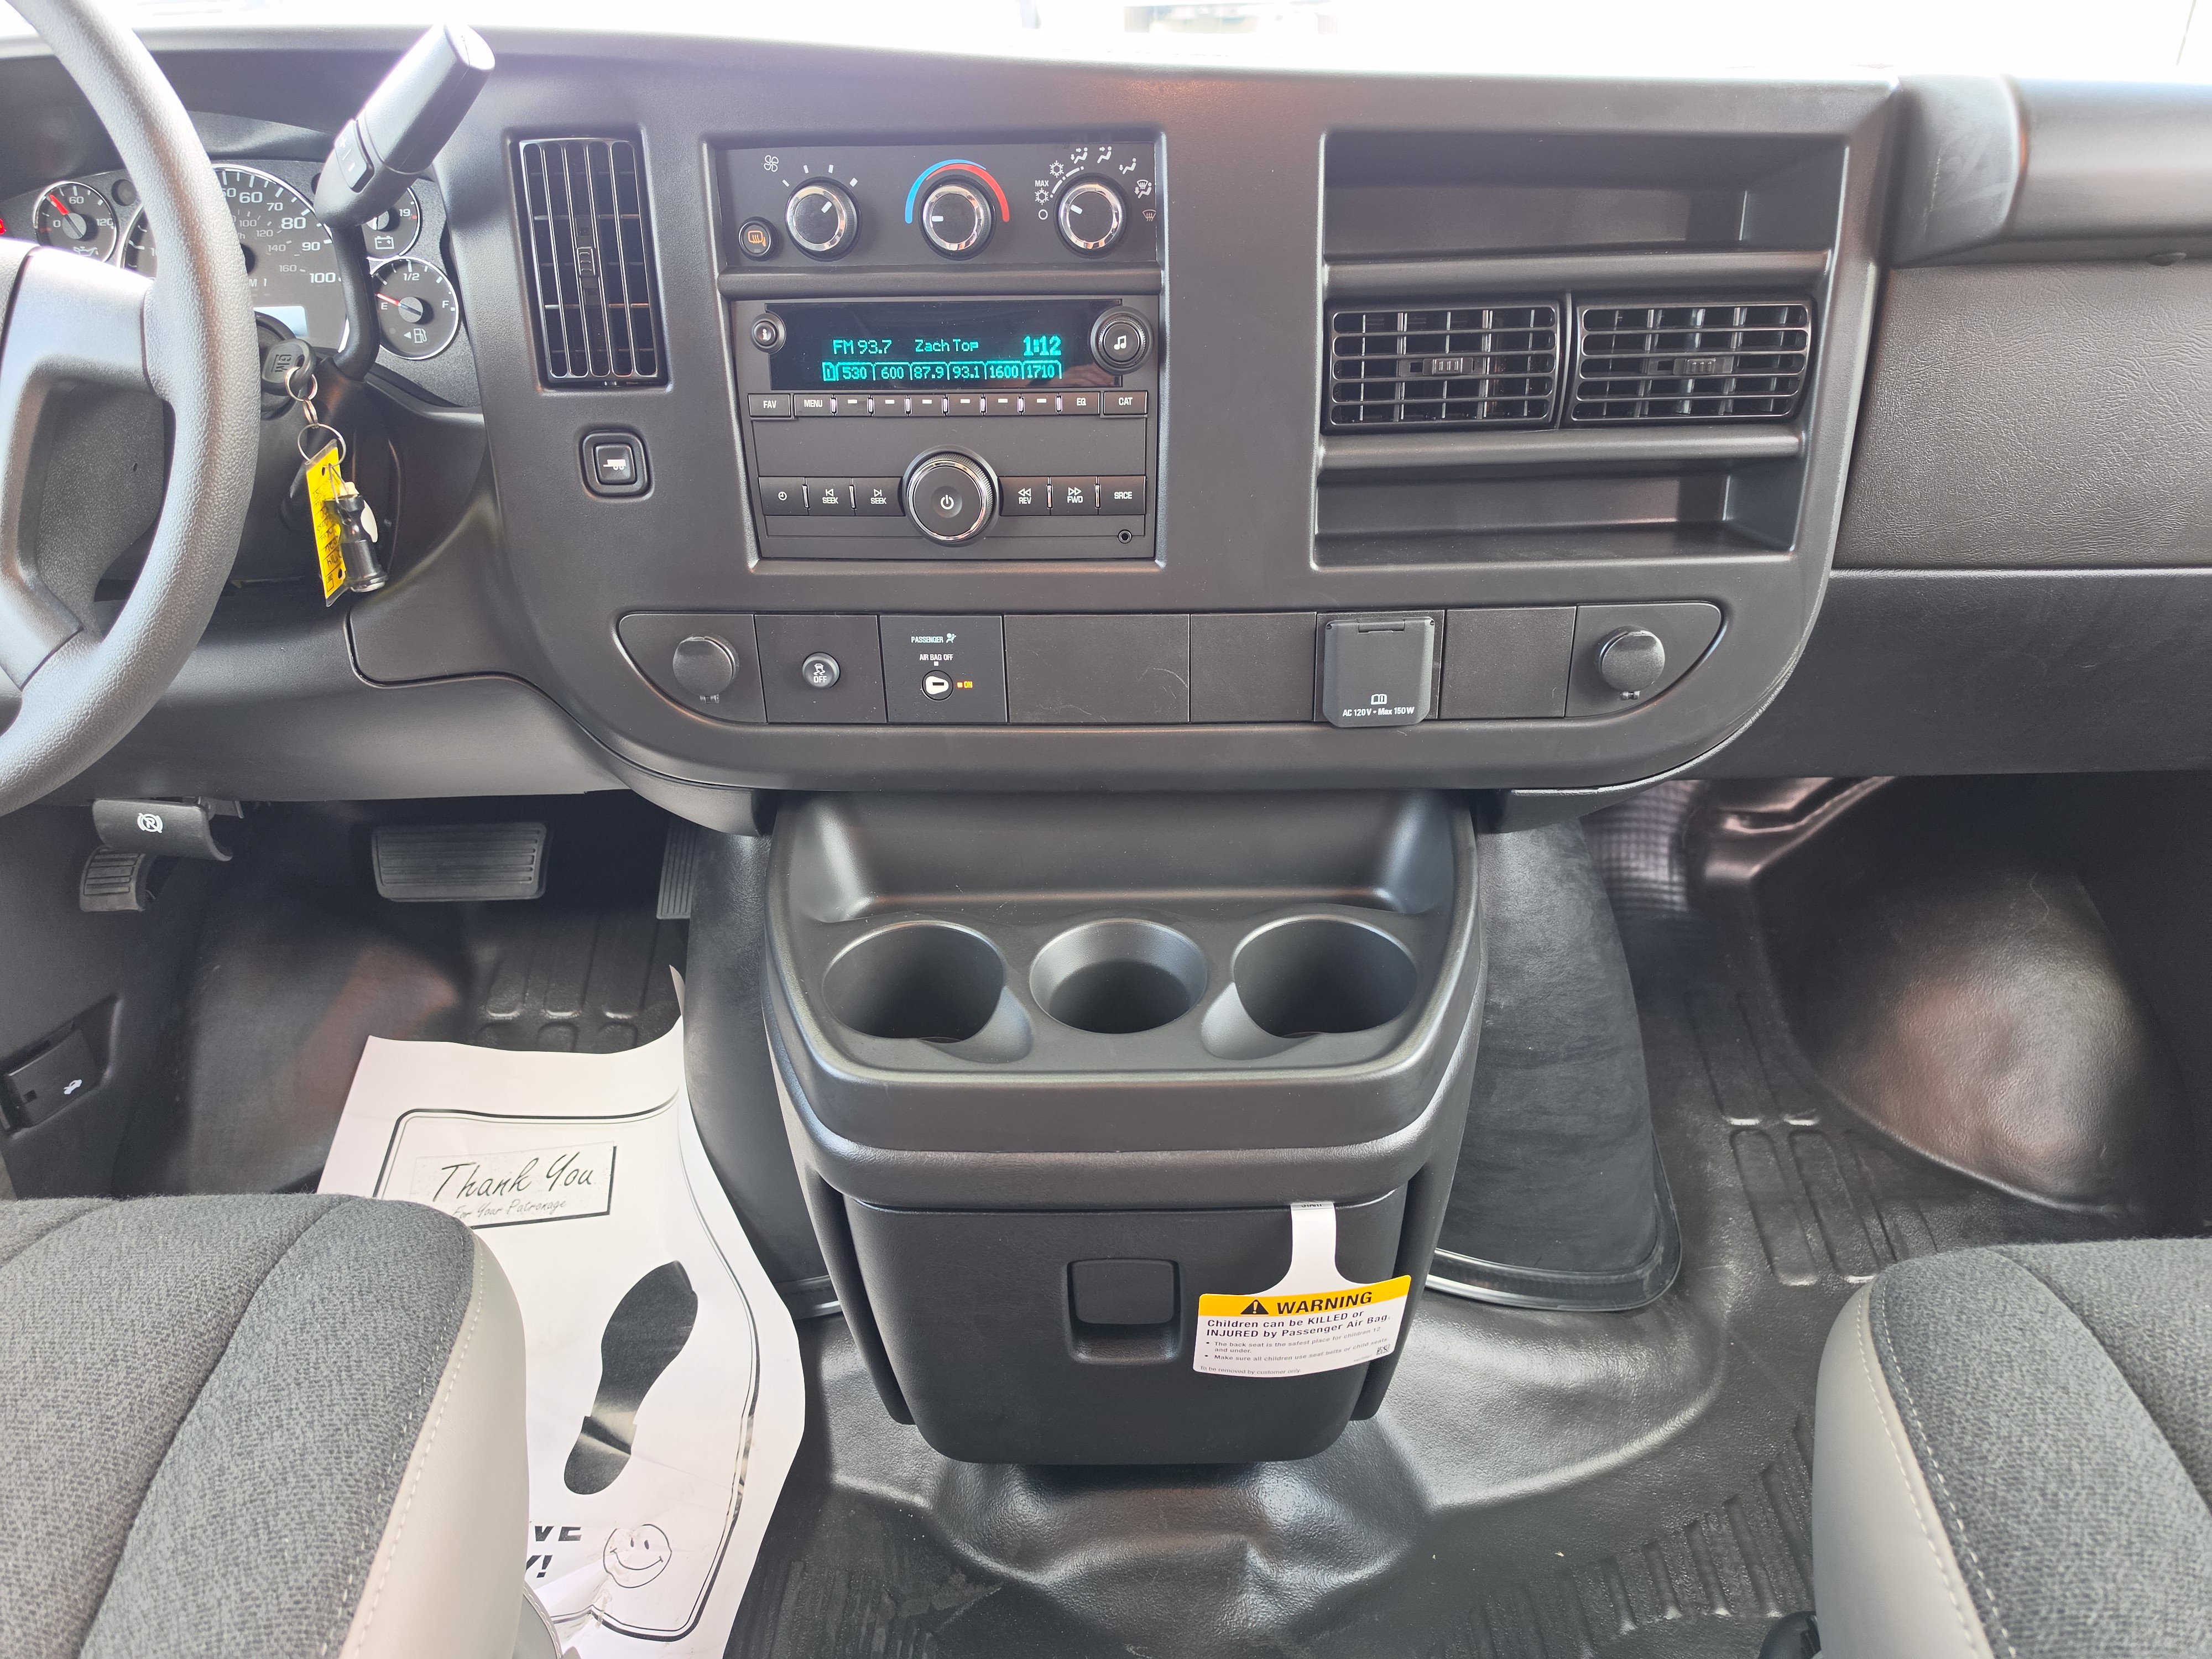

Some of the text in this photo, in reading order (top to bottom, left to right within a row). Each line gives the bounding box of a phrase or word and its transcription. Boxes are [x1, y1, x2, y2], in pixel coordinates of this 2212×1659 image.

[239, 192, 263, 203] 60
[267, 202, 283, 211] 70
[281, 217, 306, 229] 80
[302, 242, 320, 251] 90
[309, 273, 336, 283] 100
[404, 273, 420, 281] 1/2
[380, 302, 388, 310] E
[833, 335, 1062, 356] FM 93.7 Zach Top 1:12
[842, 366, 867, 379] 530
[881, 366, 904, 379] 600
[914, 366, 945, 379] 87.9
[952, 366, 980, 379] 93.1
[989, 365, 1019, 379] 1600
[1027, 364, 1055, 378] 1710
[763, 400, 777, 409] FAV
[804, 399, 823, 408] MENU
[1076, 397, 1087, 406] EQ
[1118, 397, 1133, 406] CAT
[1114, 491, 1133, 499] SRCE
[813, 675, 827, 684] OFF
[432, 1151, 596, 1202] Thank You
[477, 1201, 503, 1218] Your
[507, 1198, 567, 1216] Patronage
[1277, 1291, 1373, 1314] WARNING
[1207, 1319, 1258, 1328] Children
[1308, 1313, 1348, 1325] KILLED
[1263, 1330, 1277, 1339] by
[1281, 1324, 1343, 1337] Passenger
[1347, 1319, 1363, 1328] Air
[1344, 1330, 1371, 1338] children
[1353, 1342, 1369, 1350] child
